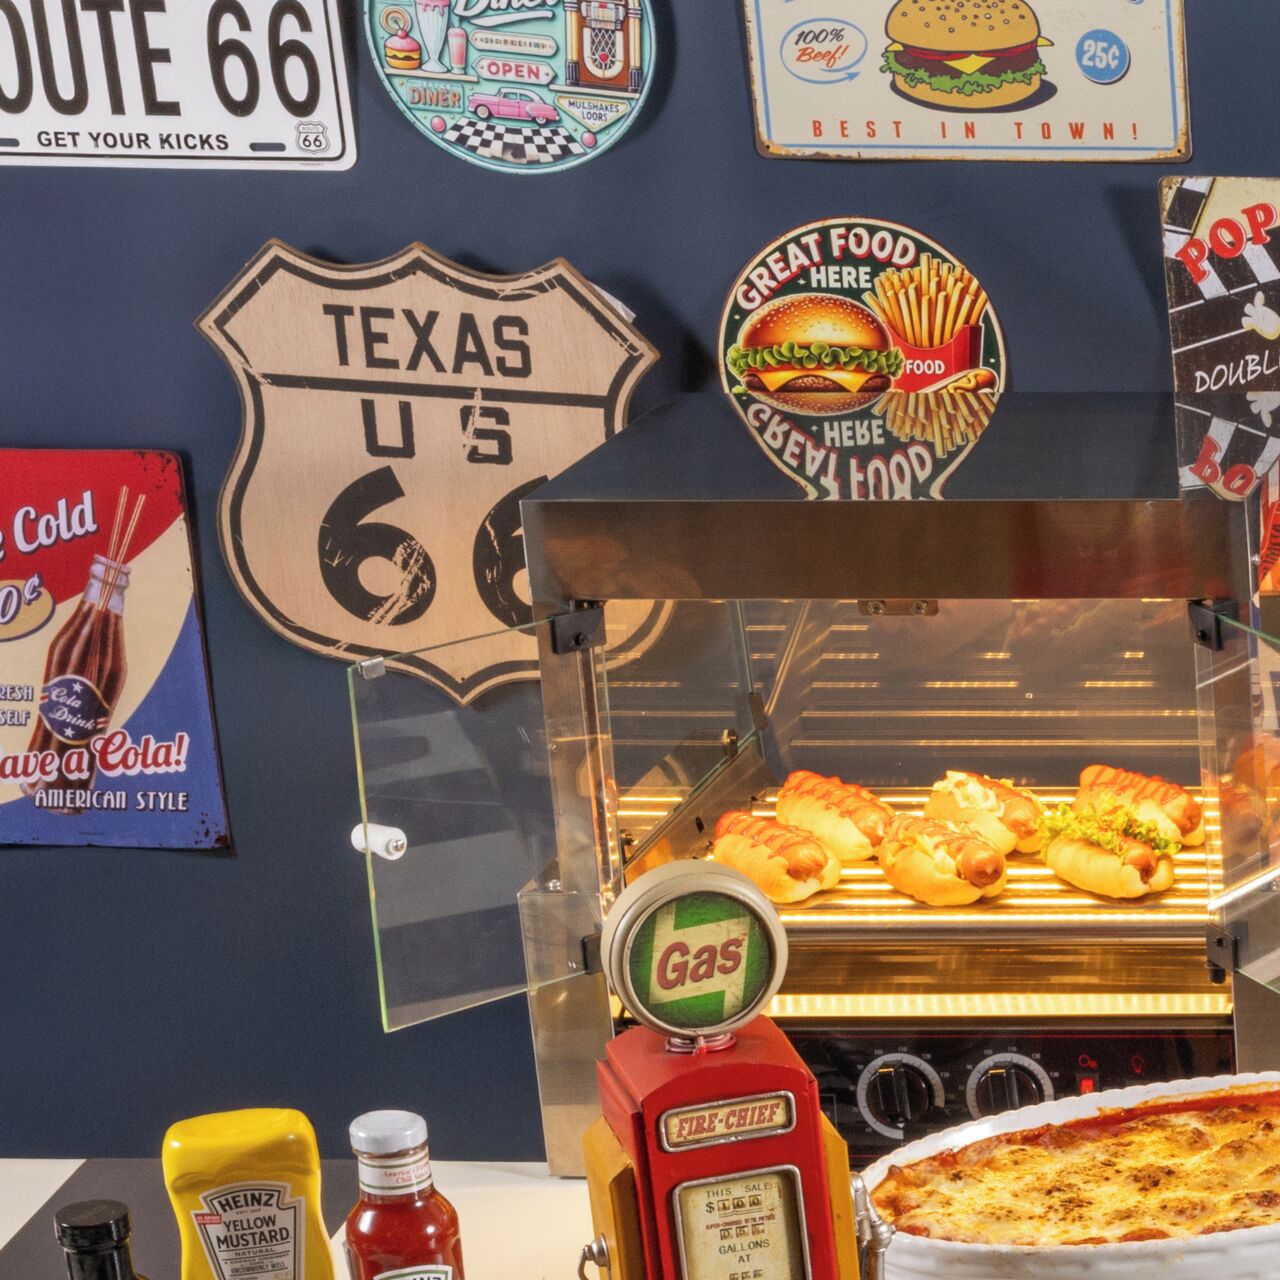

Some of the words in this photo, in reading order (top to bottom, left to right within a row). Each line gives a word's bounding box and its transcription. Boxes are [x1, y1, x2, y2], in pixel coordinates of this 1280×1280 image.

[794, 28, 845, 45] 100%
[0, 0, 181, 116] OUTE
[207, 0, 320, 118] 66
[796, 44, 849, 68] Beef!
[487, 61, 541, 81] OPEN
[408, 86, 462, 108] DINER
[38, 131, 80, 147] GET
[88, 132, 150, 150] YOUR
[159, 134, 229, 150] KICKS
[812, 119, 903, 138] BEST
[941, 121, 976, 139] IN
[1015, 122, 1138, 140] TOWN!
[736, 232, 822, 310] GREAT
[830, 227, 916, 266] FOOD
[810, 266, 872, 288] HERE
[322, 303, 532, 378] TEXAS
[905, 360, 945, 375] FOOD
[13, 490, 98, 555] Cold
[92, 728, 189, 776] Cola!
[35, 789, 127, 810] AMERICAN
[136, 791, 189, 811] STYLE
[657, 938, 744, 990] Gas
[677, 1102, 780, 1138] FIRE-CHIEF
[217, 1192, 275, 1213] HEINZ
[706, 1188, 732, 1199] THIS
[223, 1214, 277, 1232] YELLOW
[216, 1227, 290, 1249] MUSTARD
[719, 1239, 770, 1254] GALLONS
[235, 1247, 276, 1257] NATURAL
[738, 1254, 751, 1264] AT
